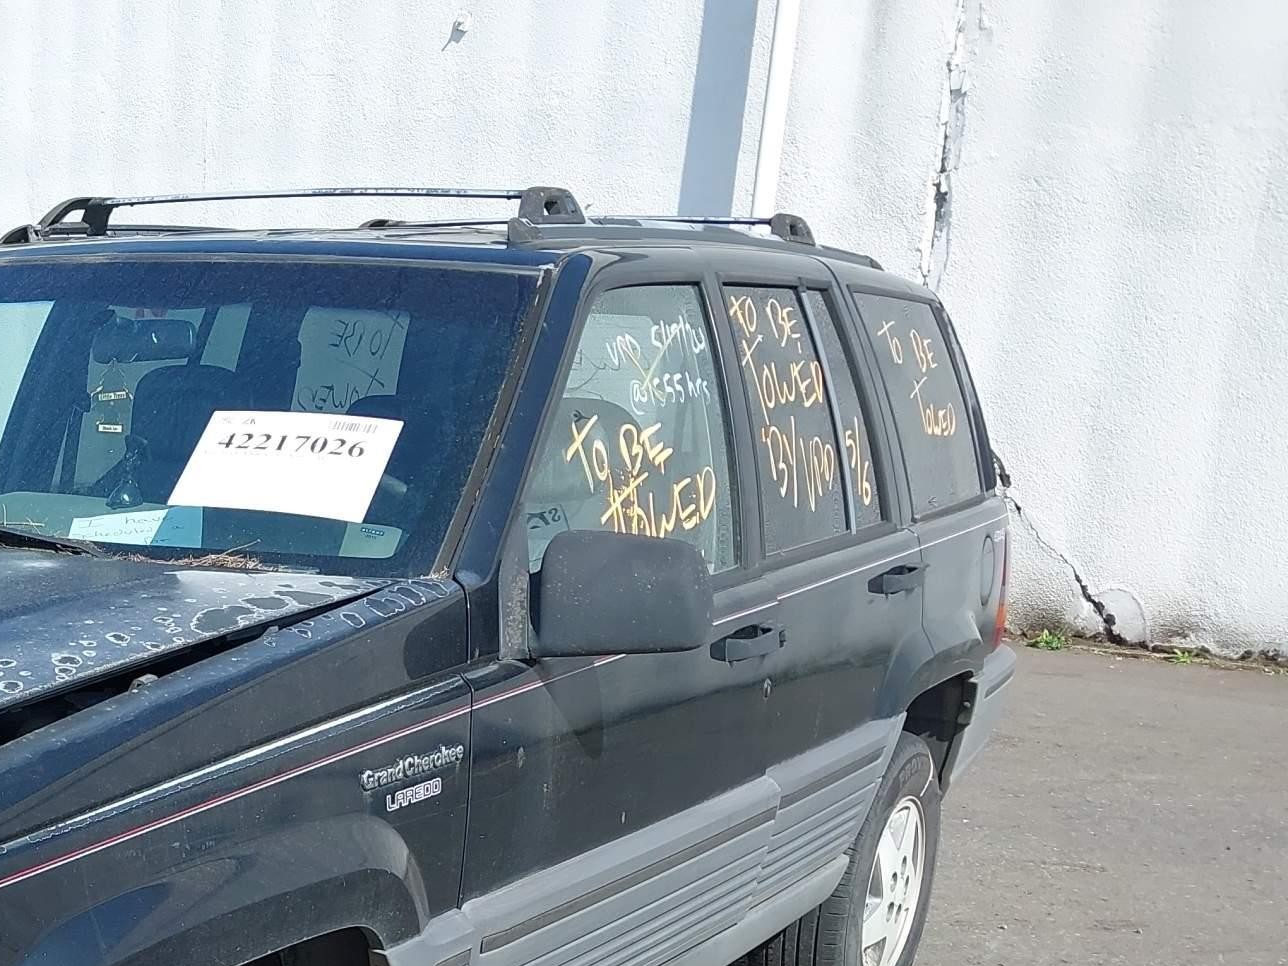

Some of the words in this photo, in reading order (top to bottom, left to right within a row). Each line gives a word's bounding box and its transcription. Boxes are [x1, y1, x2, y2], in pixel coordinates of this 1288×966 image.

[909, 329, 939, 373] BE
[741, 334, 823, 426] TOWED
[909, 376, 956, 436] TOWED
[218, 432, 369, 458] 42217026
[619, 422, 673, 475] BE
[360, 759, 404, 791] Grand
[404, 743, 464, 779] Cherokee
[386, 777, 442, 812] LAREDO
